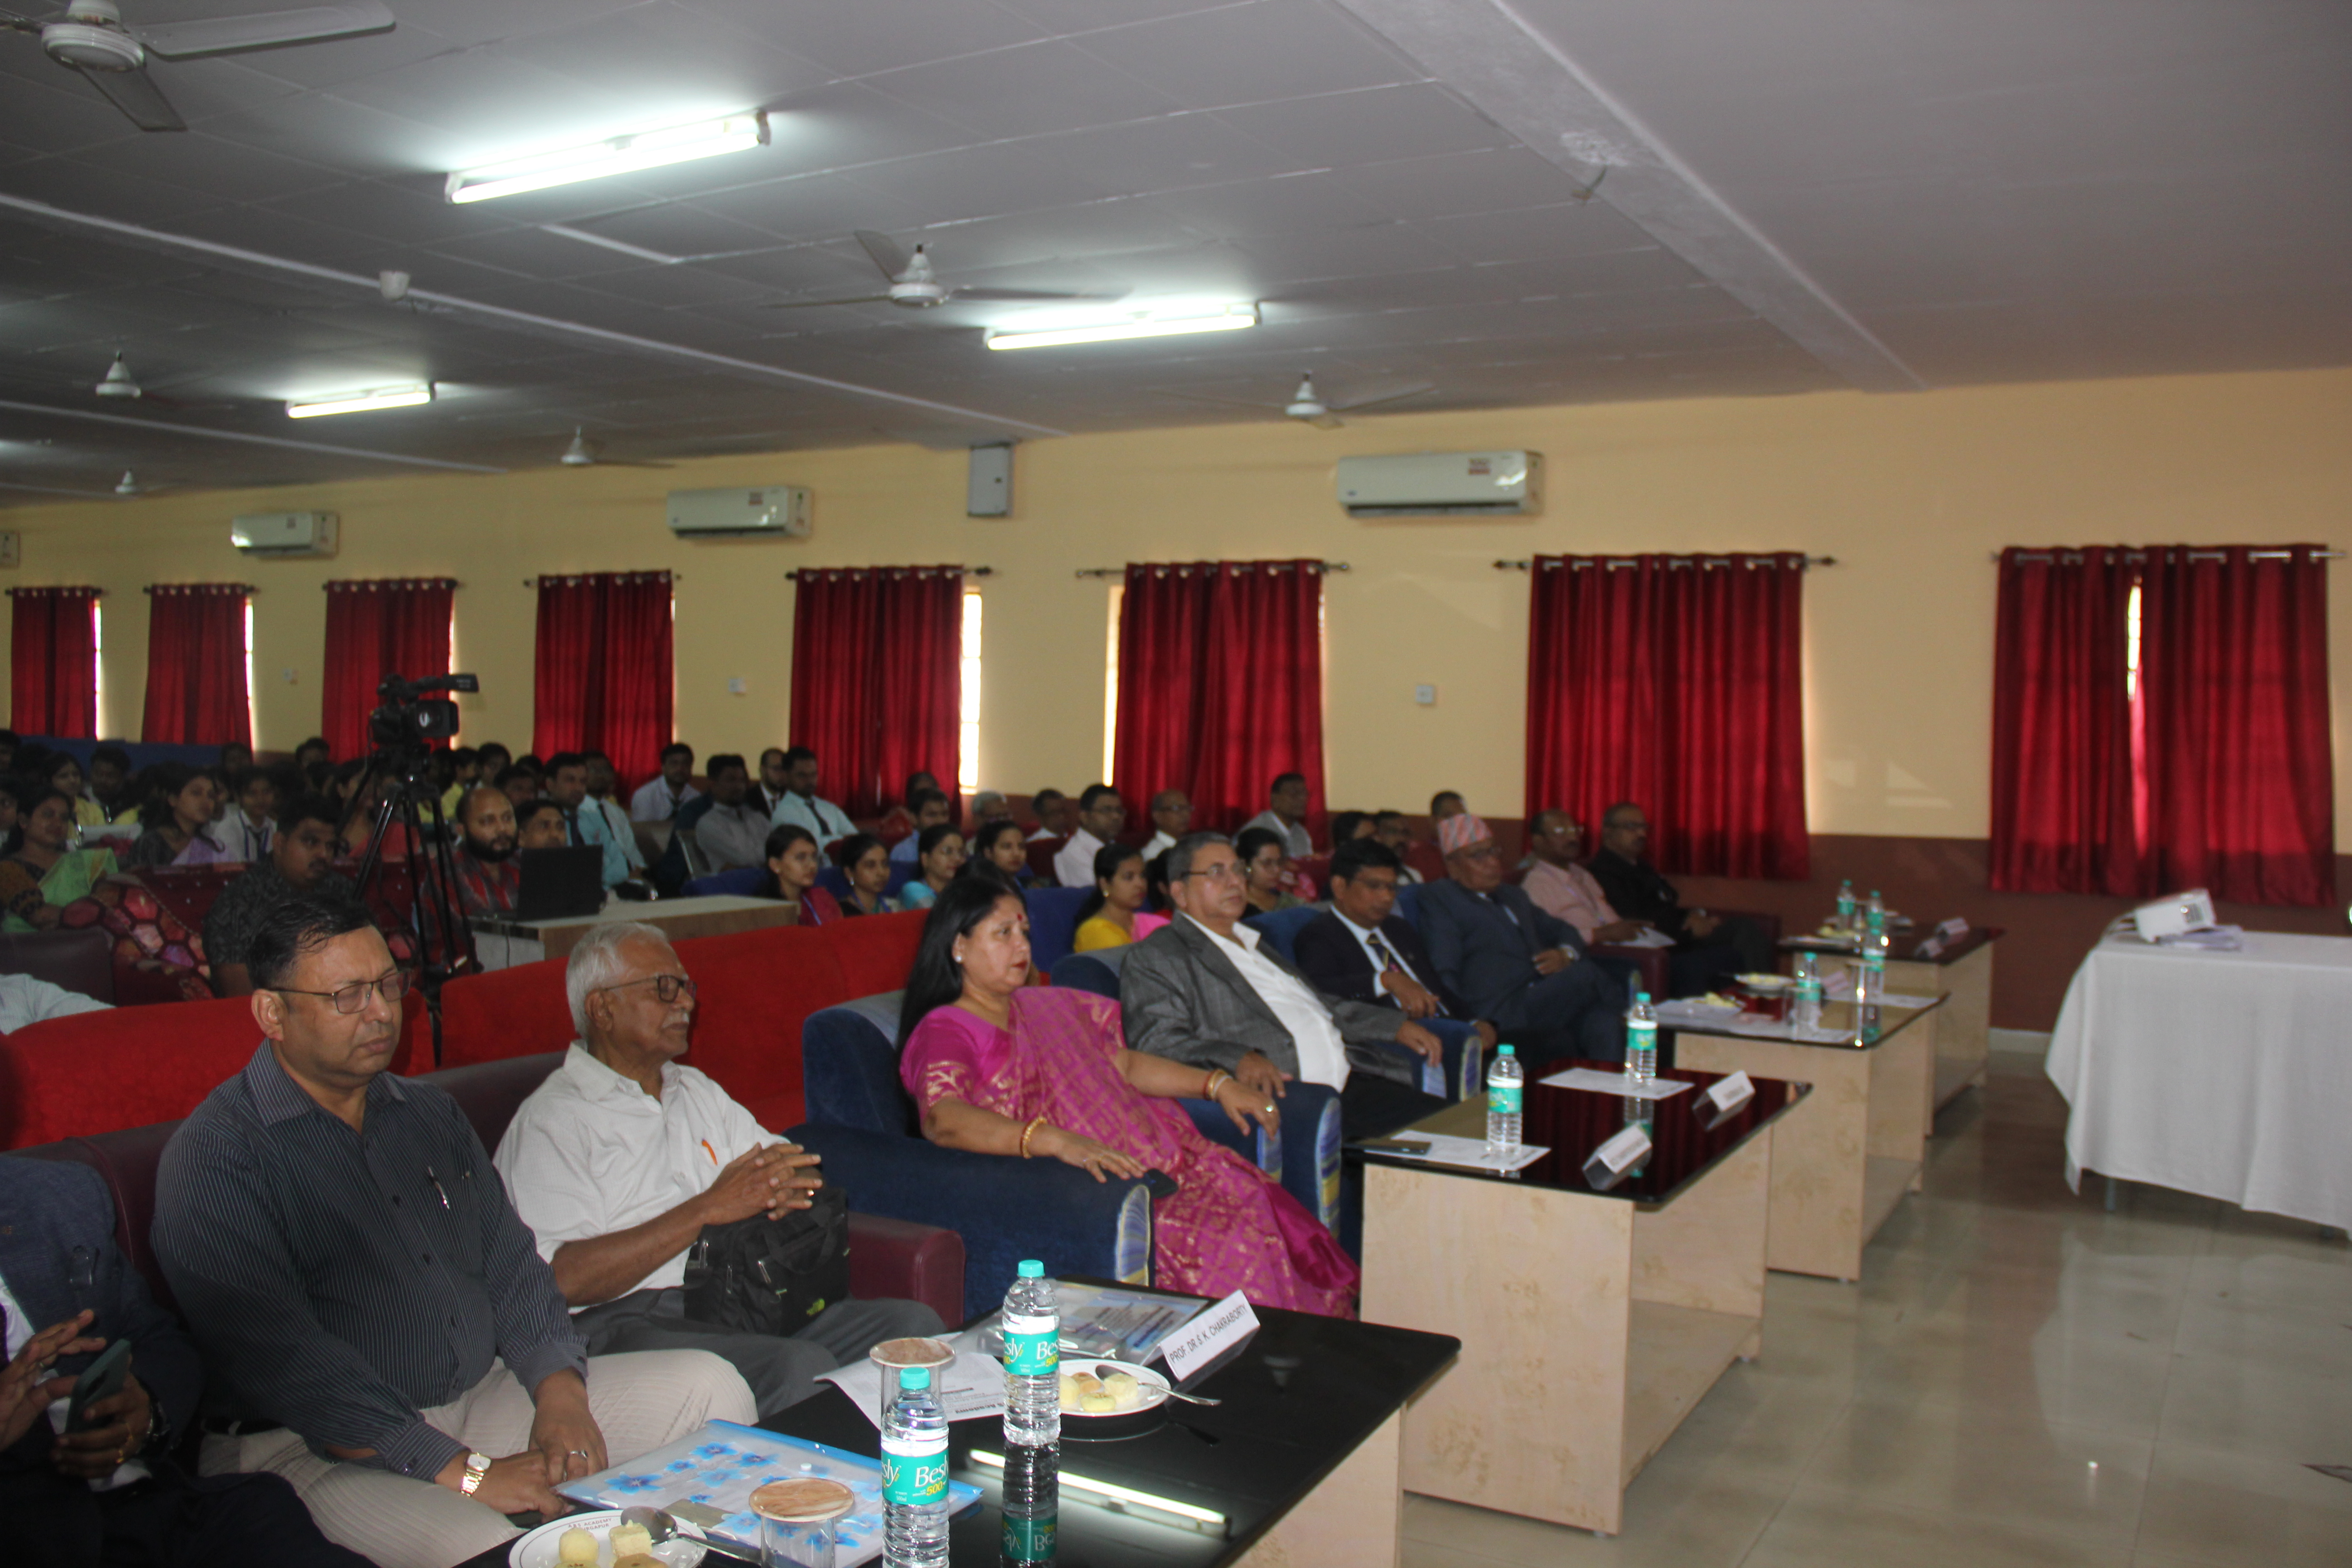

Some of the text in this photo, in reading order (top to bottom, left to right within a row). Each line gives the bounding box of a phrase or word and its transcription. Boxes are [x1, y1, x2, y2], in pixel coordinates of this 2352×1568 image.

[1209, 1303, 1248, 1336] CHAKRABORTY
[926, 1480, 943, 1496] 500
[584, 1518, 612, 1526] ACADEMY
